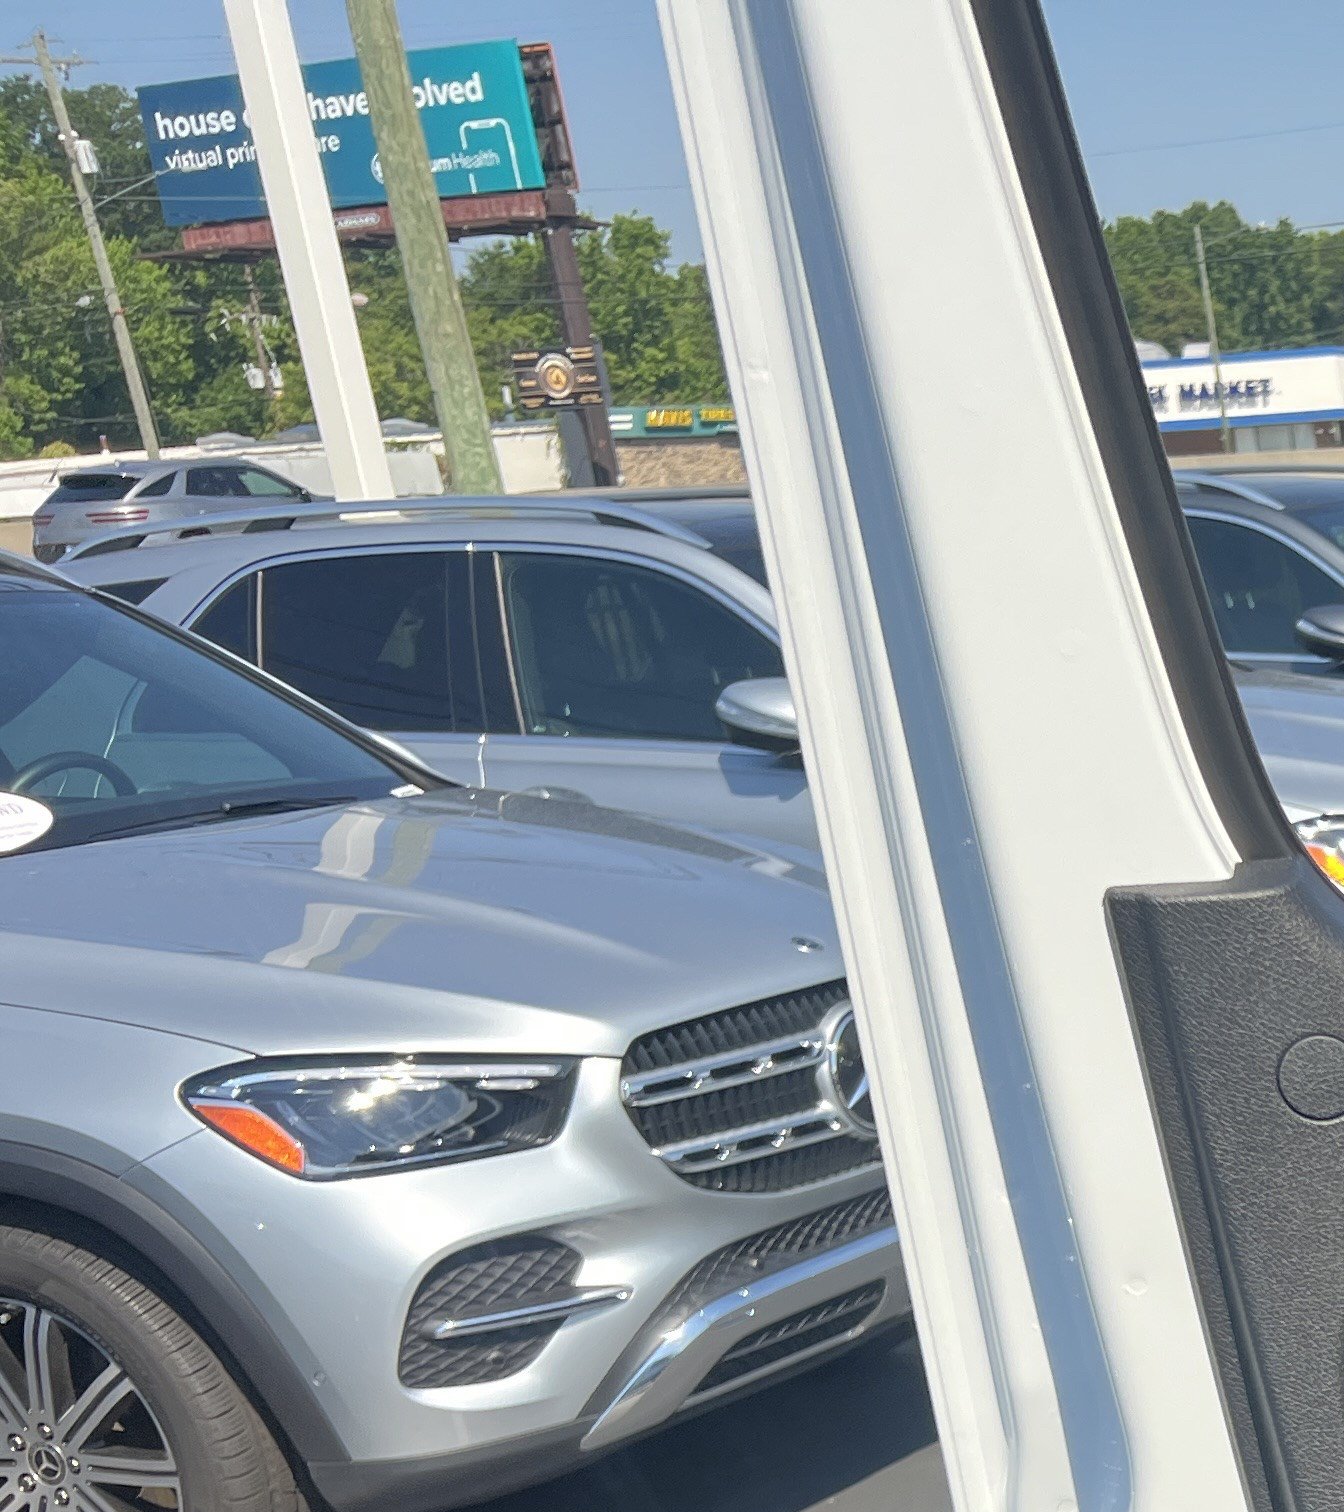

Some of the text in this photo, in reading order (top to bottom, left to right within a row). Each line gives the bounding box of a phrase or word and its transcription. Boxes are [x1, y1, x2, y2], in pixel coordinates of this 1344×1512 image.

[154, 109, 236, 140] house
[306, 91, 370, 121] have
[412, 71, 484, 109] olved
[165, 144, 223, 170] virtual
[1178, 378, 1273, 402] MARKET
